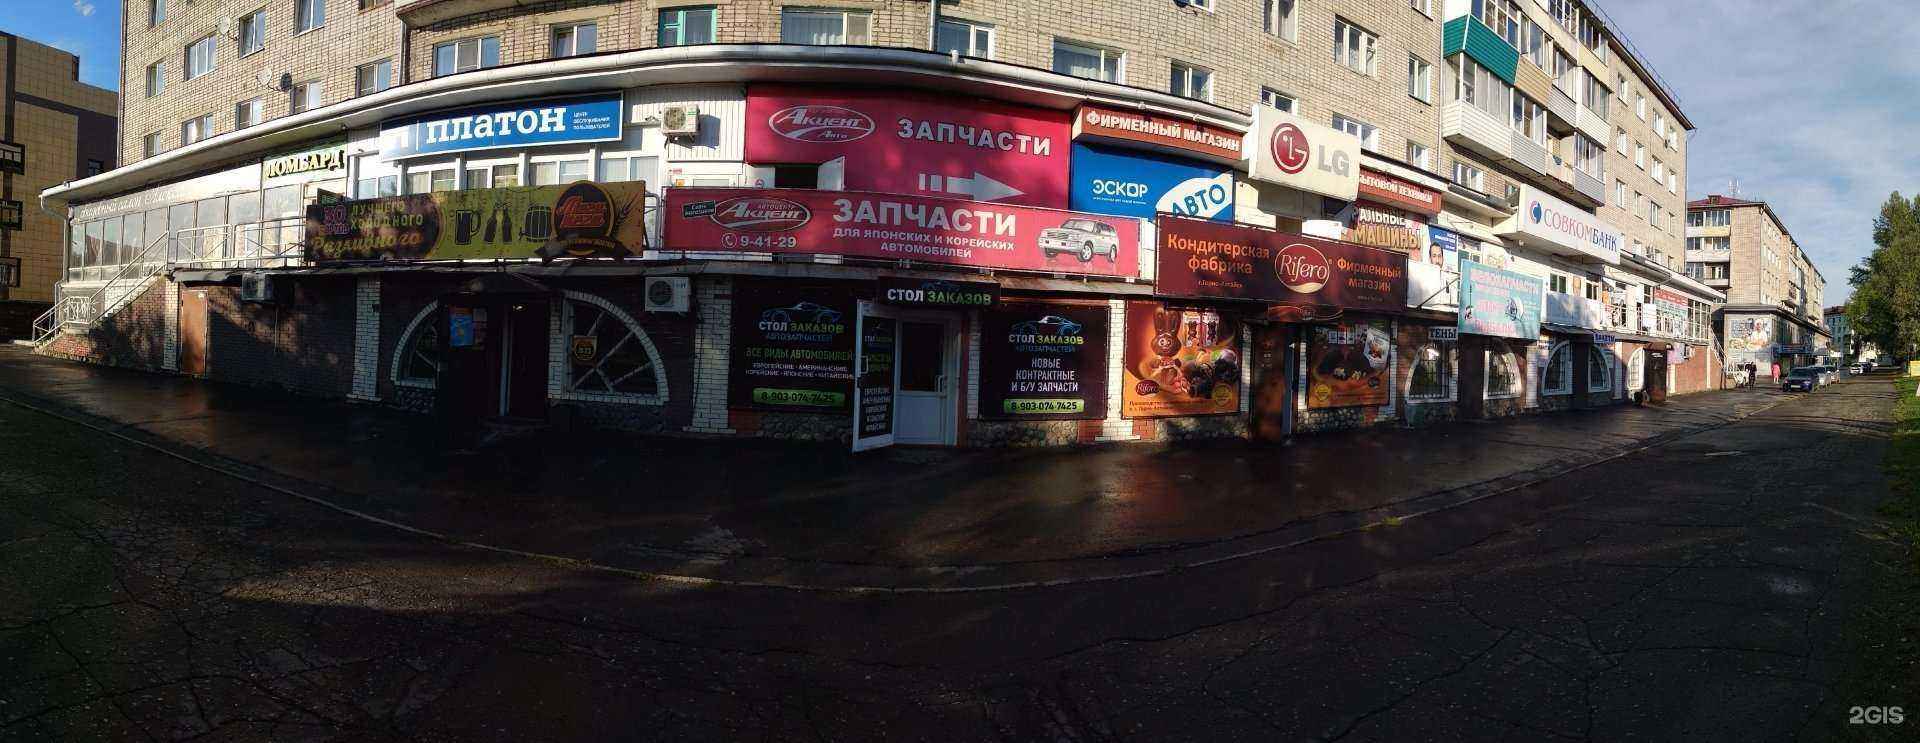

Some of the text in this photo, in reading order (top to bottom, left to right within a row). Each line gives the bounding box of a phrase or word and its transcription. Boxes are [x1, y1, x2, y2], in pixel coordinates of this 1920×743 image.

[897, 117, 1052, 156] ЗАПЧАСТИ
[1086, 110, 1239, 152] ФИРМЕННЫЙ МАГАЗИН
[263, 149, 344, 177] ЛОМБАРД
[1318, 144, 1350, 177] LG
[1092, 179, 1148, 198] ЭСКОР
[1172, 184, 1226, 216] АВТО
[832, 198, 1016, 237] ЗАПЧАСТИ
[739, 235, 798, 248] 9-41-29
[832, 228, 1015, 252] ДЛЯ ЯПОНСКИХ И КОРЕЙСКИХ
[1353, 223, 1421, 249] МАШИНЫ
[1544, 207, 1617, 253] СОВКОМБАНК
[880, 242, 972, 259] АВТОМОБИЛЕЙ
[1167, 233, 1270, 259] Кондитерская
[1188, 255, 1254, 275] фабрика
[1279, 254, 1328, 282] Rifero
[1337, 256, 1402, 279] Фирменный
[887, 287, 992, 306] СТОЛ ЗАКАЗОВ
[758, 321, 845, 334] СТОЛ ЗАКАЗОВ
[1008, 333, 1084, 346] СТОЛ ЗАКАЗОВ
[1031, 358, 1061, 369] НОВЫЕ
[1011, 381, 1079, 393] И Б/У ЗАПЧАСТИ
[1015, 370, 1075, 382] КОНТРАКТНЫЕ
